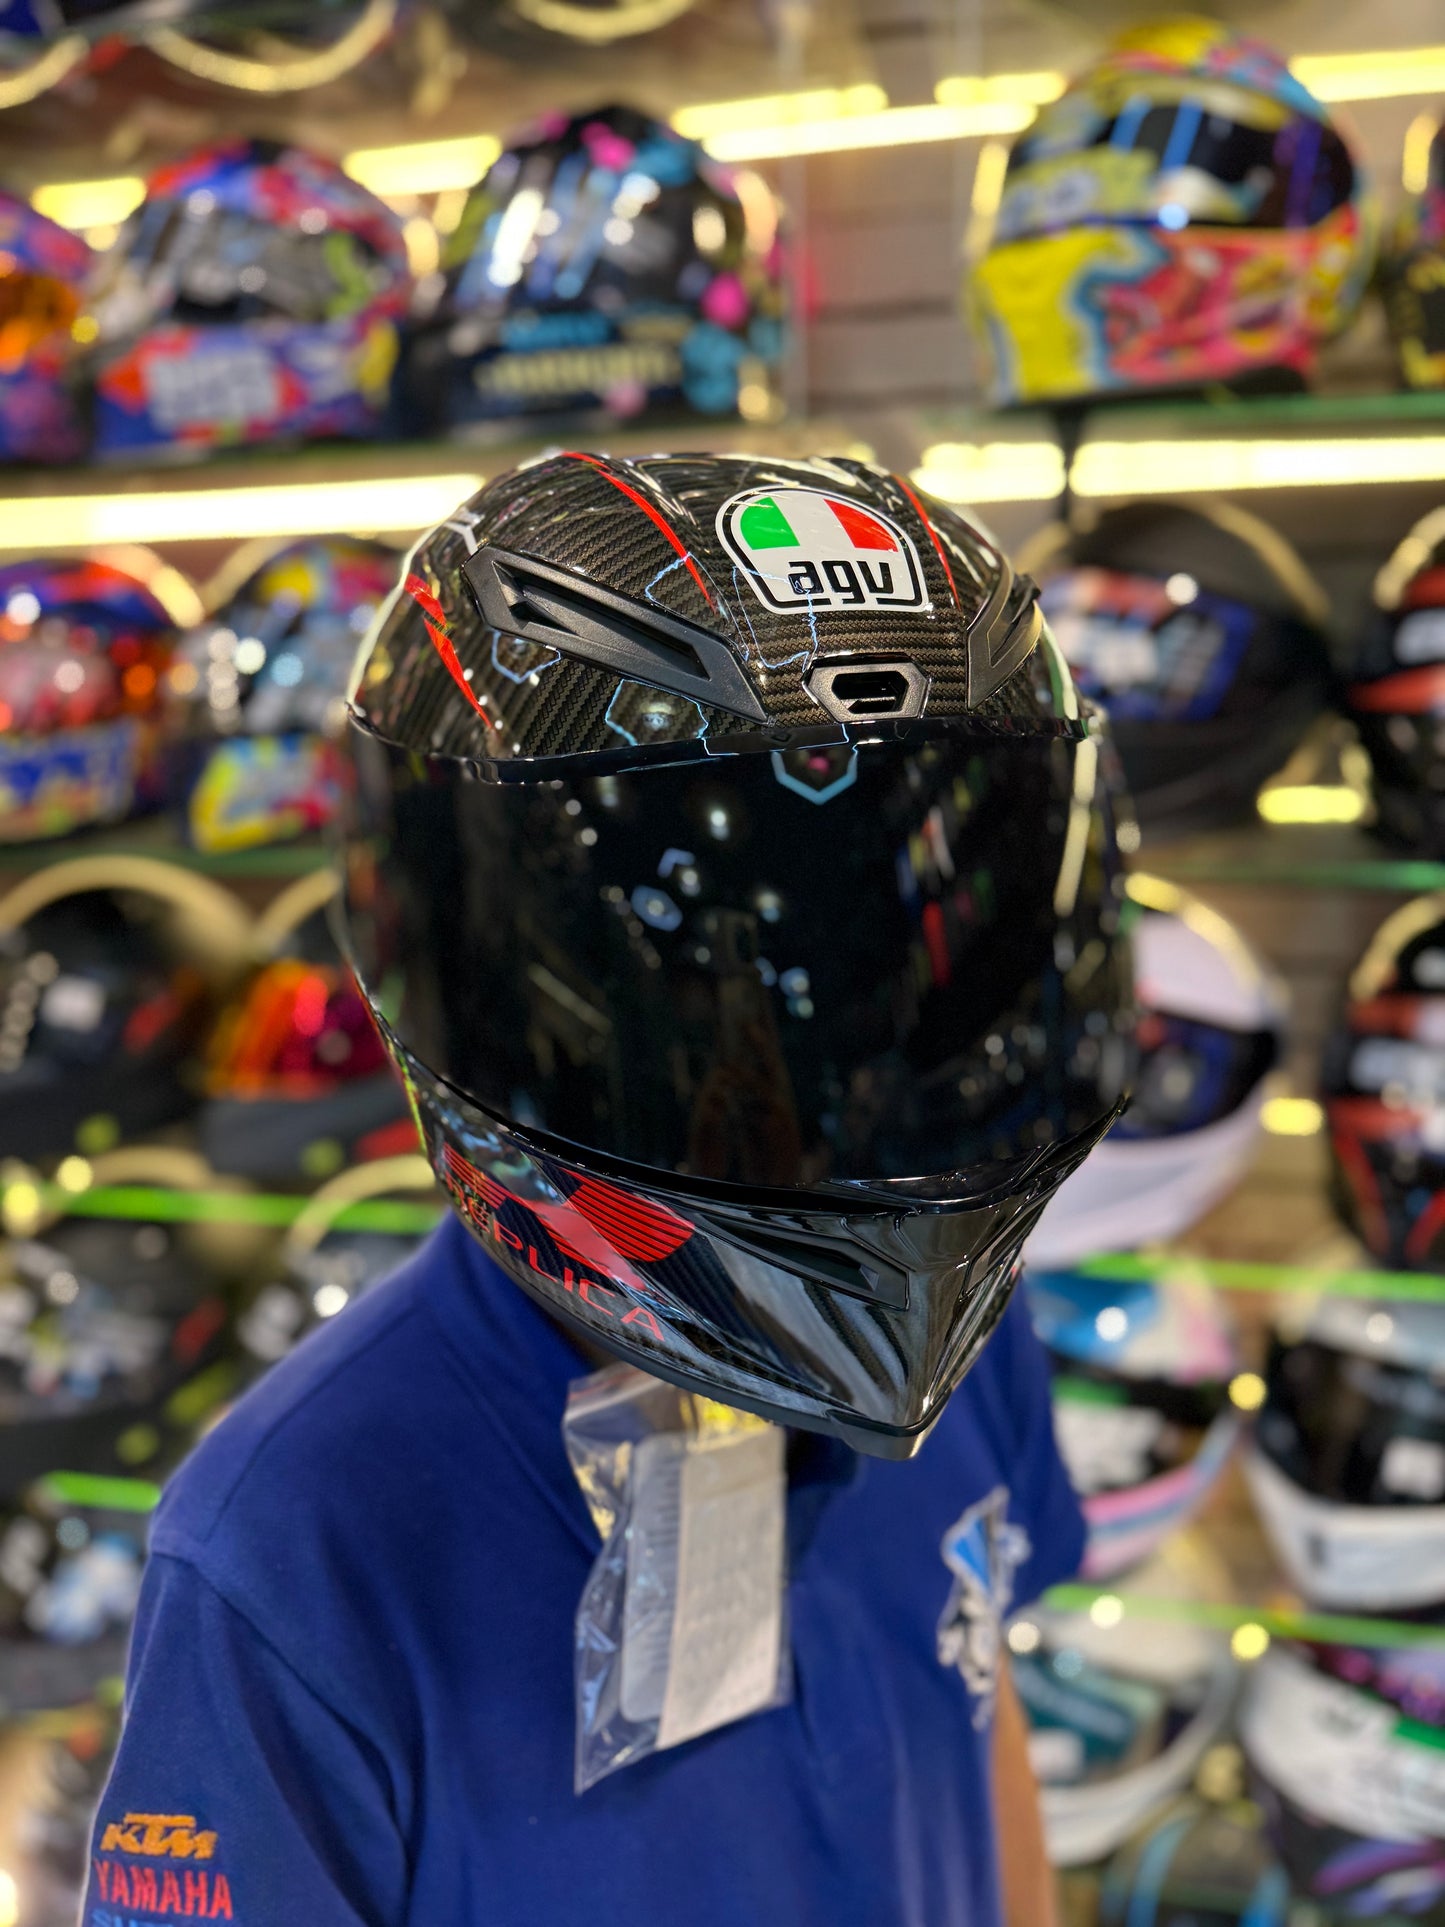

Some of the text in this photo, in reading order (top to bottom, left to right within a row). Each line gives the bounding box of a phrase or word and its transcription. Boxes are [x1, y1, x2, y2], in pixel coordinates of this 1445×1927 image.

[788, 560, 894, 604] agv
[100, 1812, 218, 1859] KTM
[93, 1858, 233, 1920] YAMAHA
